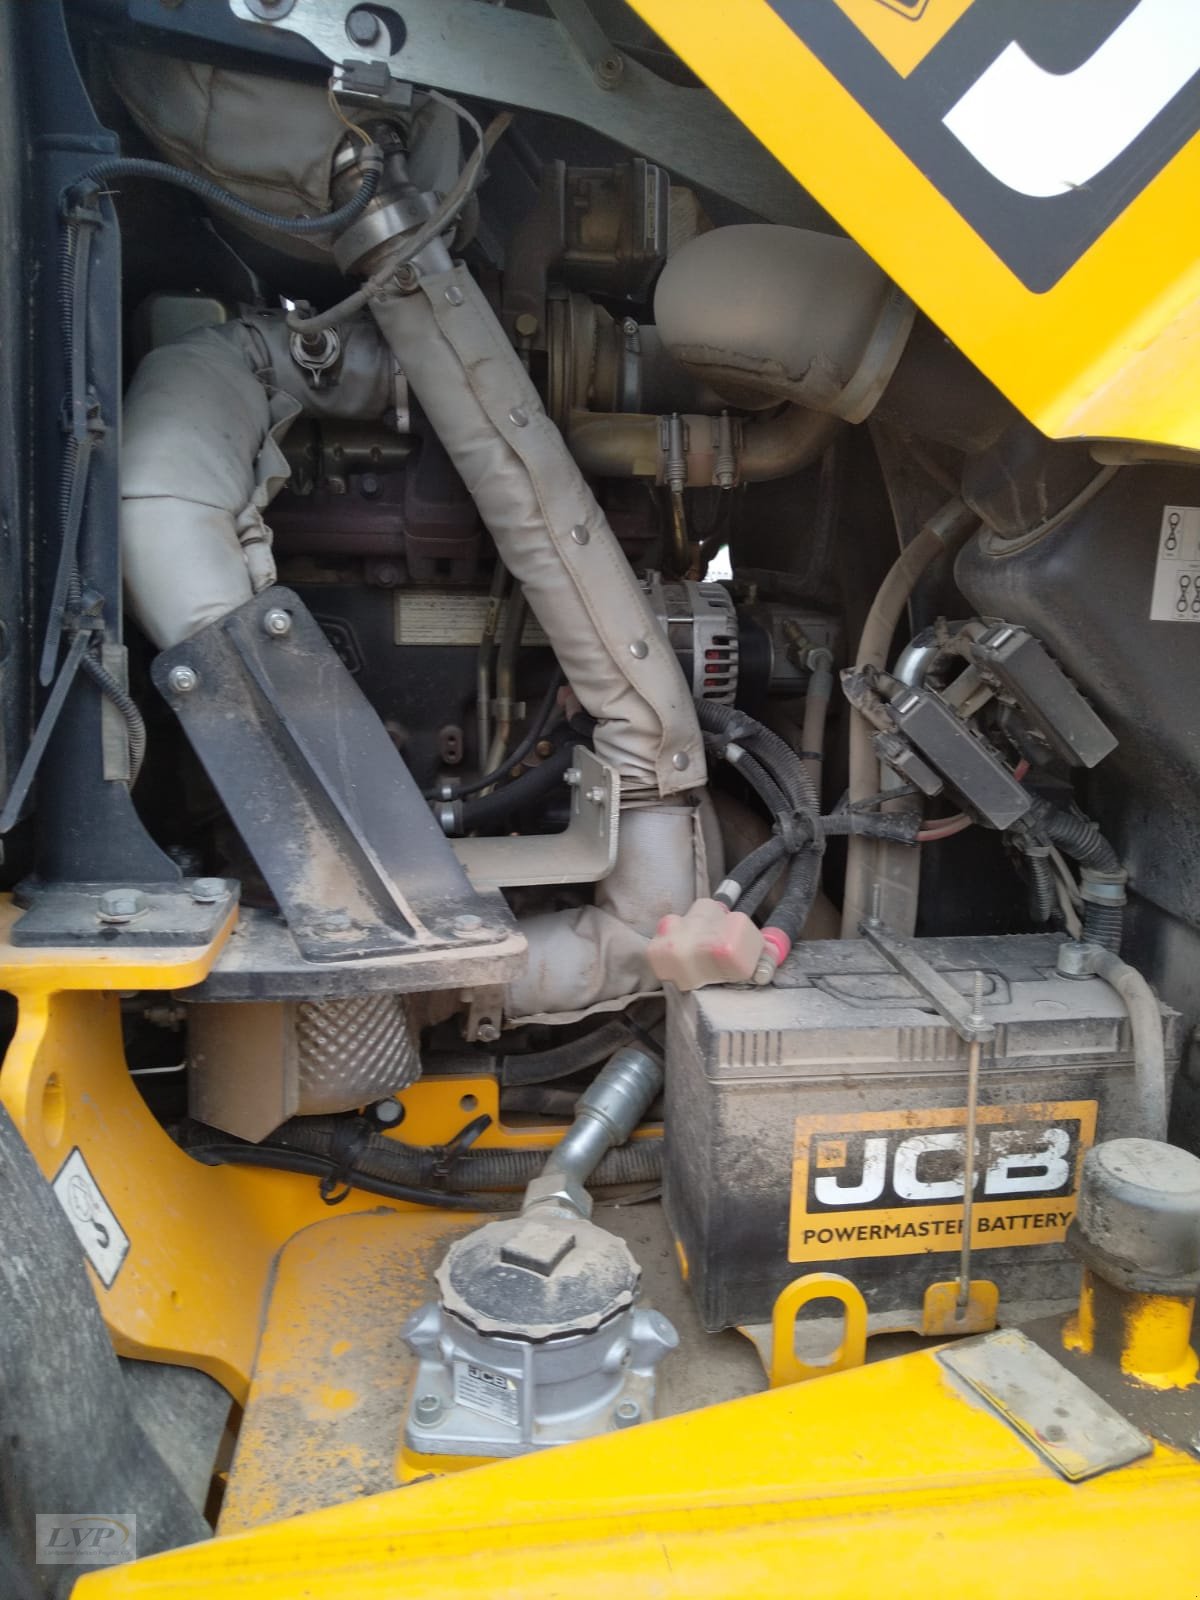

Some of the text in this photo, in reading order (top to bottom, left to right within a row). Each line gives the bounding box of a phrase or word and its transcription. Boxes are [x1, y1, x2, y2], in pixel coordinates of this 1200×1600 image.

[815, 1128, 1071, 1205] JCB
[977, 1211, 1073, 1233] BATTERY
[468, 1367, 507, 1389] JCB
